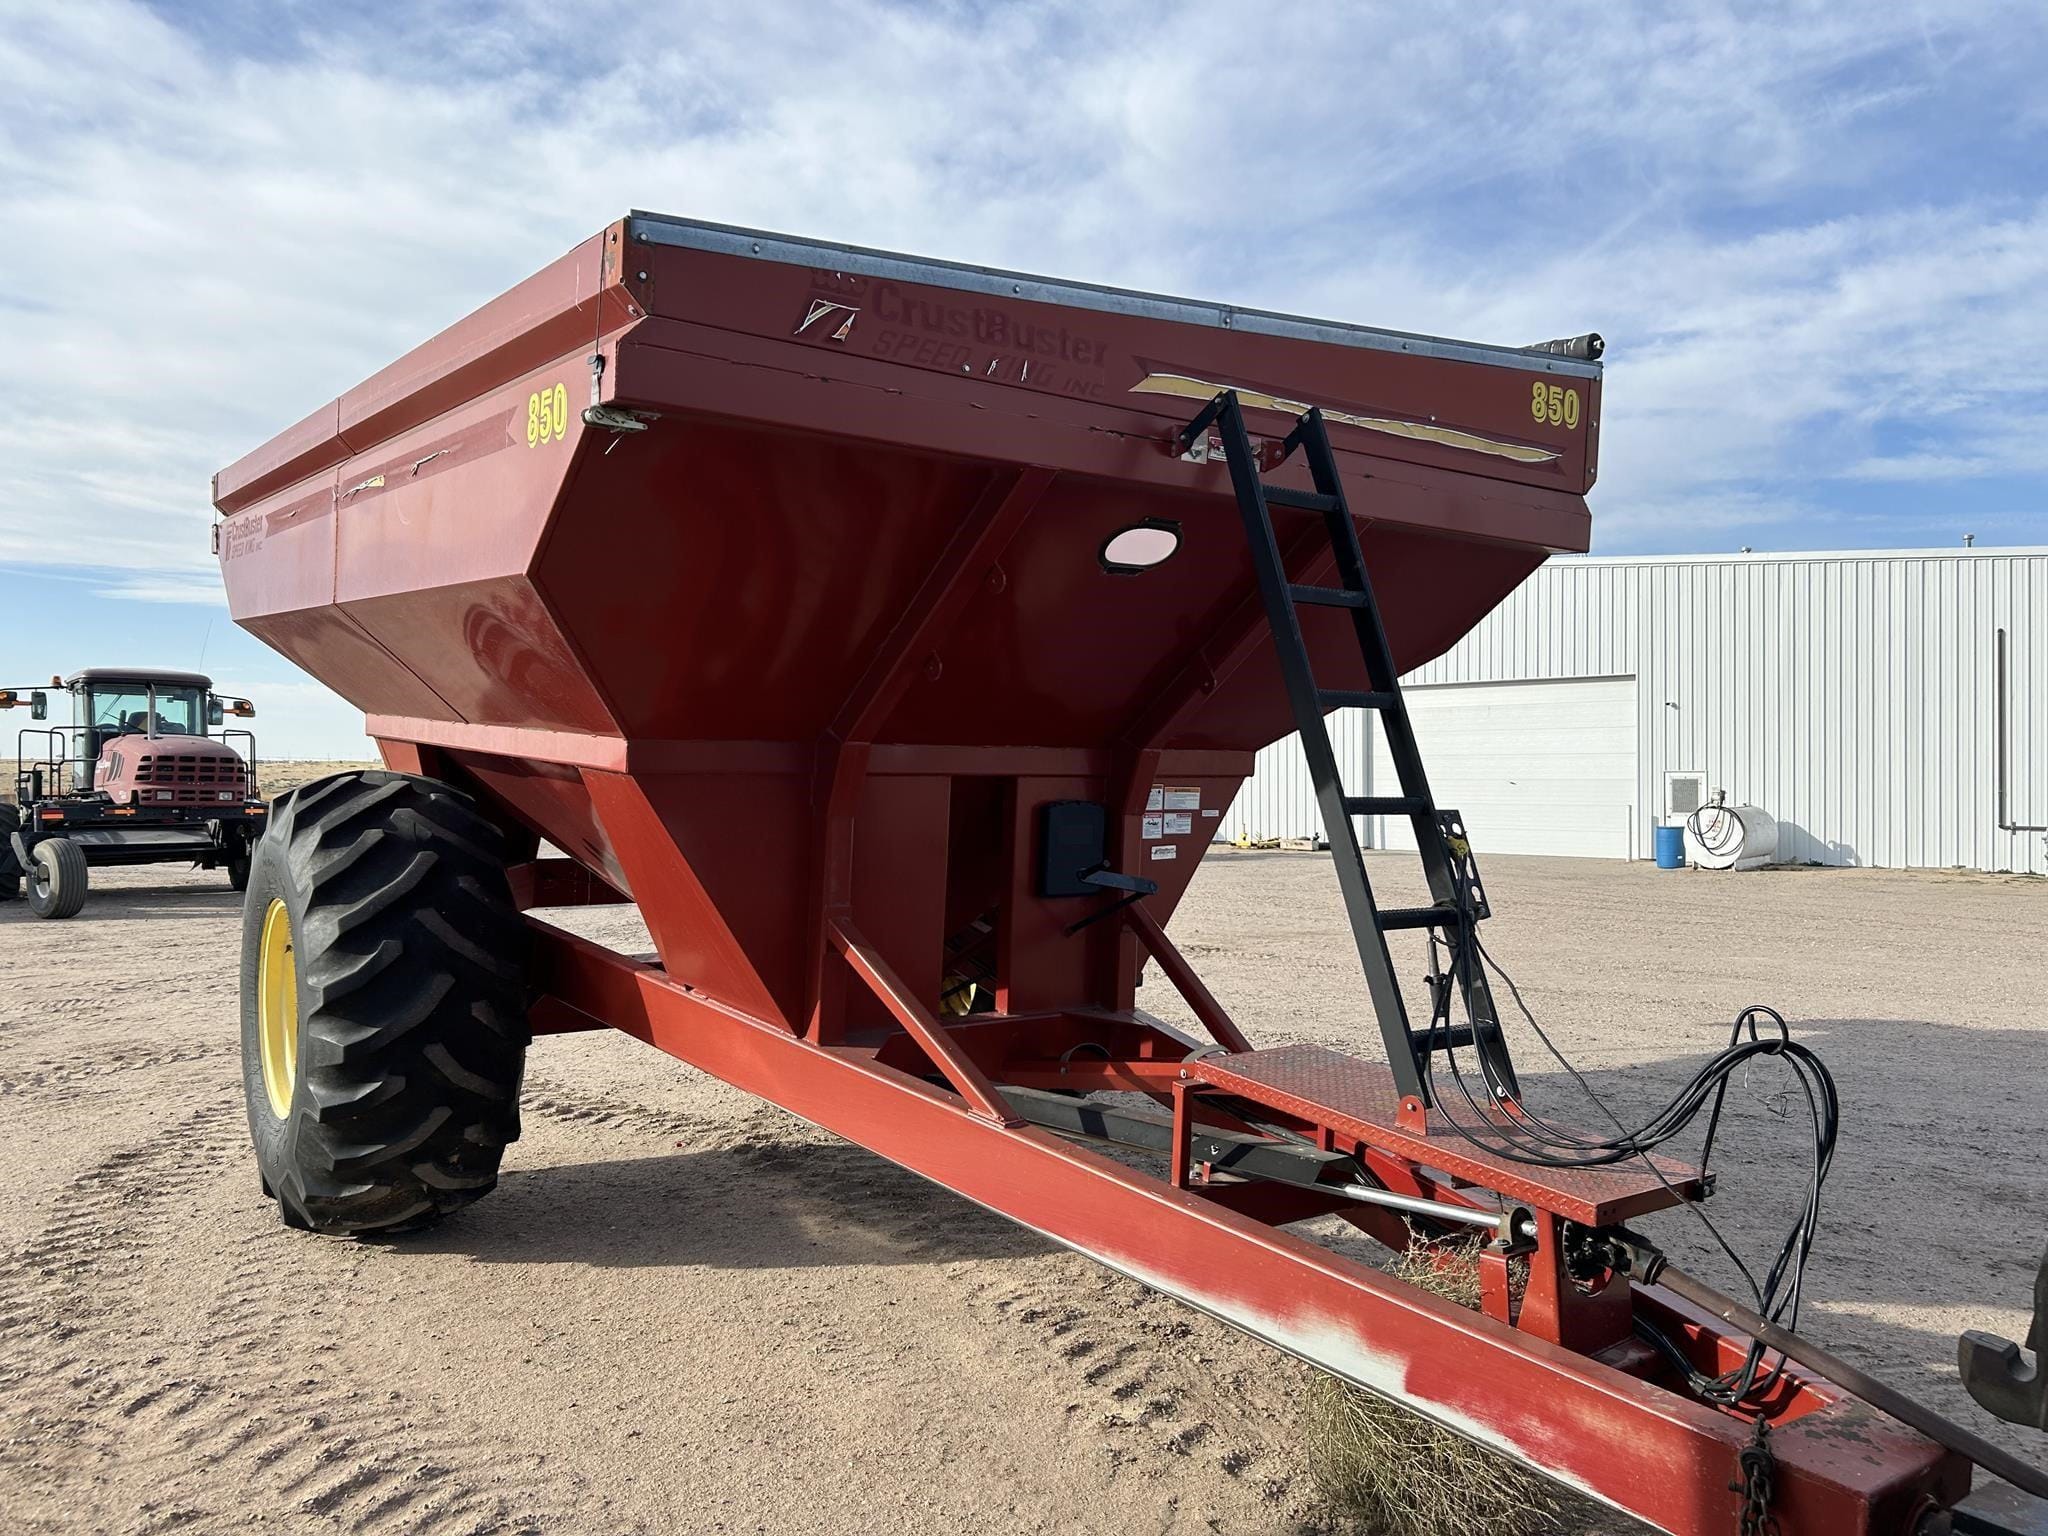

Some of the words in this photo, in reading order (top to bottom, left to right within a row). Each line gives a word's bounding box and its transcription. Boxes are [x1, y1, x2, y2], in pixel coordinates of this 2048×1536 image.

[873, 282, 1108, 365] CrustBuster
[873, 331, 971, 368] SPEED
[527, 383, 568, 449] 850
[1531, 381, 1579, 430] 850
